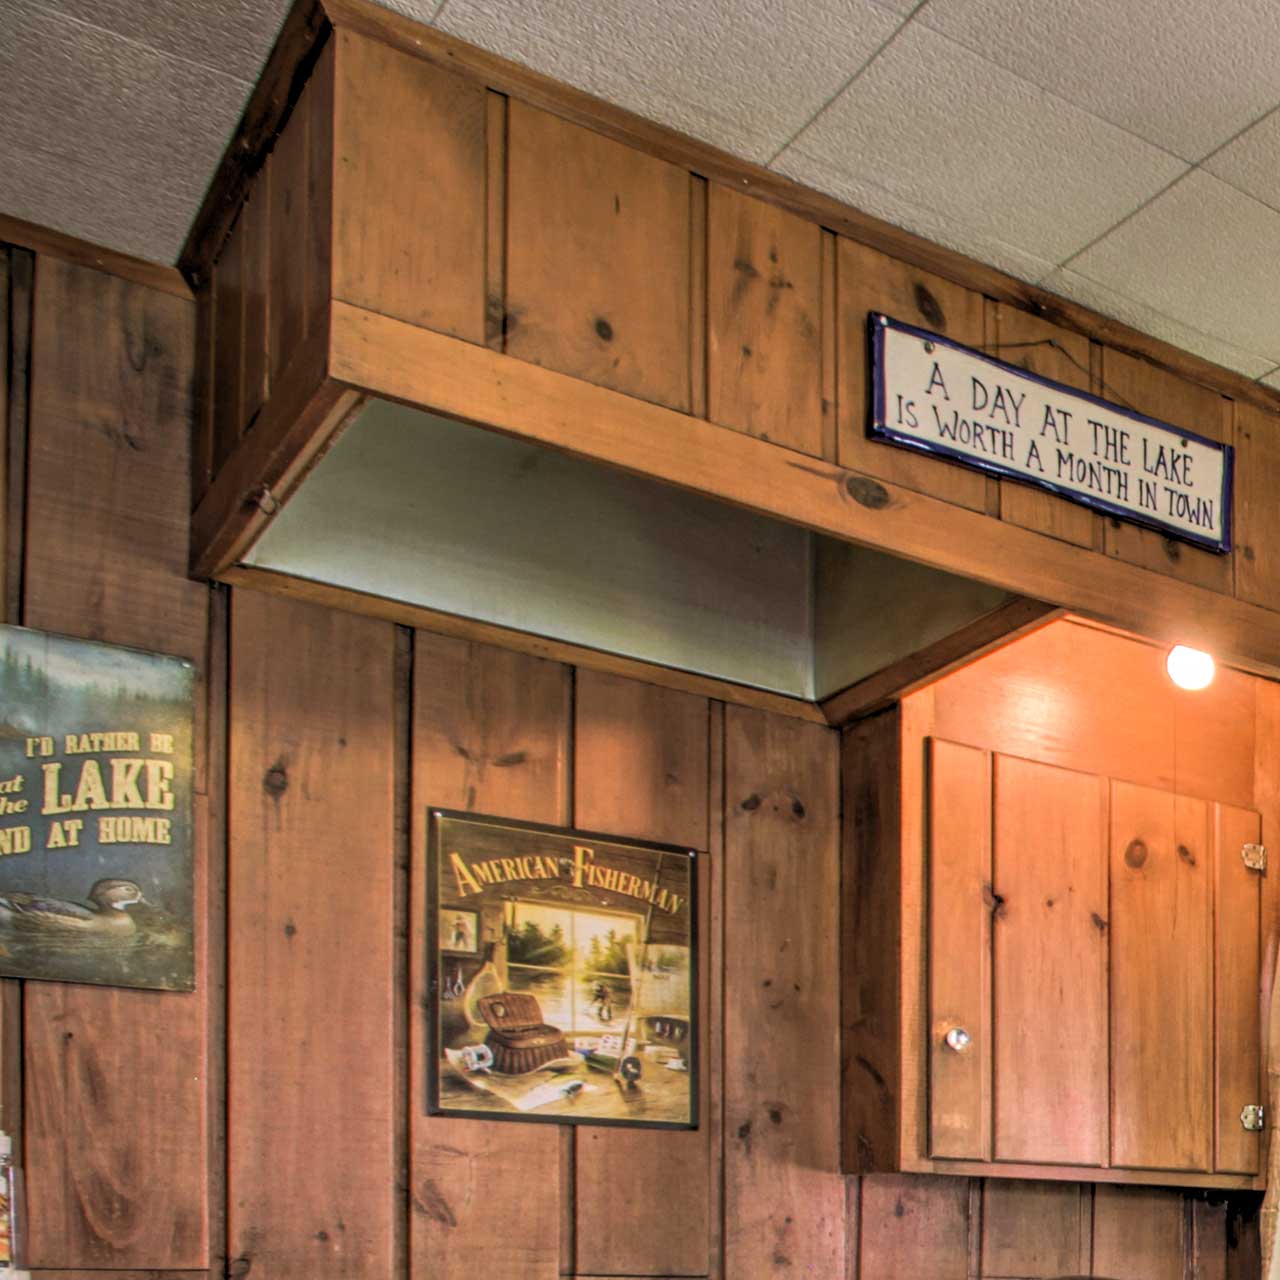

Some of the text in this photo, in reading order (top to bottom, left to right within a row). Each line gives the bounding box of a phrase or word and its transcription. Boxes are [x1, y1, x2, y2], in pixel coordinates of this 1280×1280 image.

[925, 362, 1193, 487] A DAY AT THE LAKE
[896, 395, 1214, 530] IS WORTH A MONTH IN TOWN
[26, 732, 174, 757] I'D RATHER BE
[0, 797, 28, 815] he
[41, 758, 174, 815] LAKE
[0, 816, 171, 856] ND AT HOME
[449, 846, 685, 914] AMERICAN FISHERMAN
